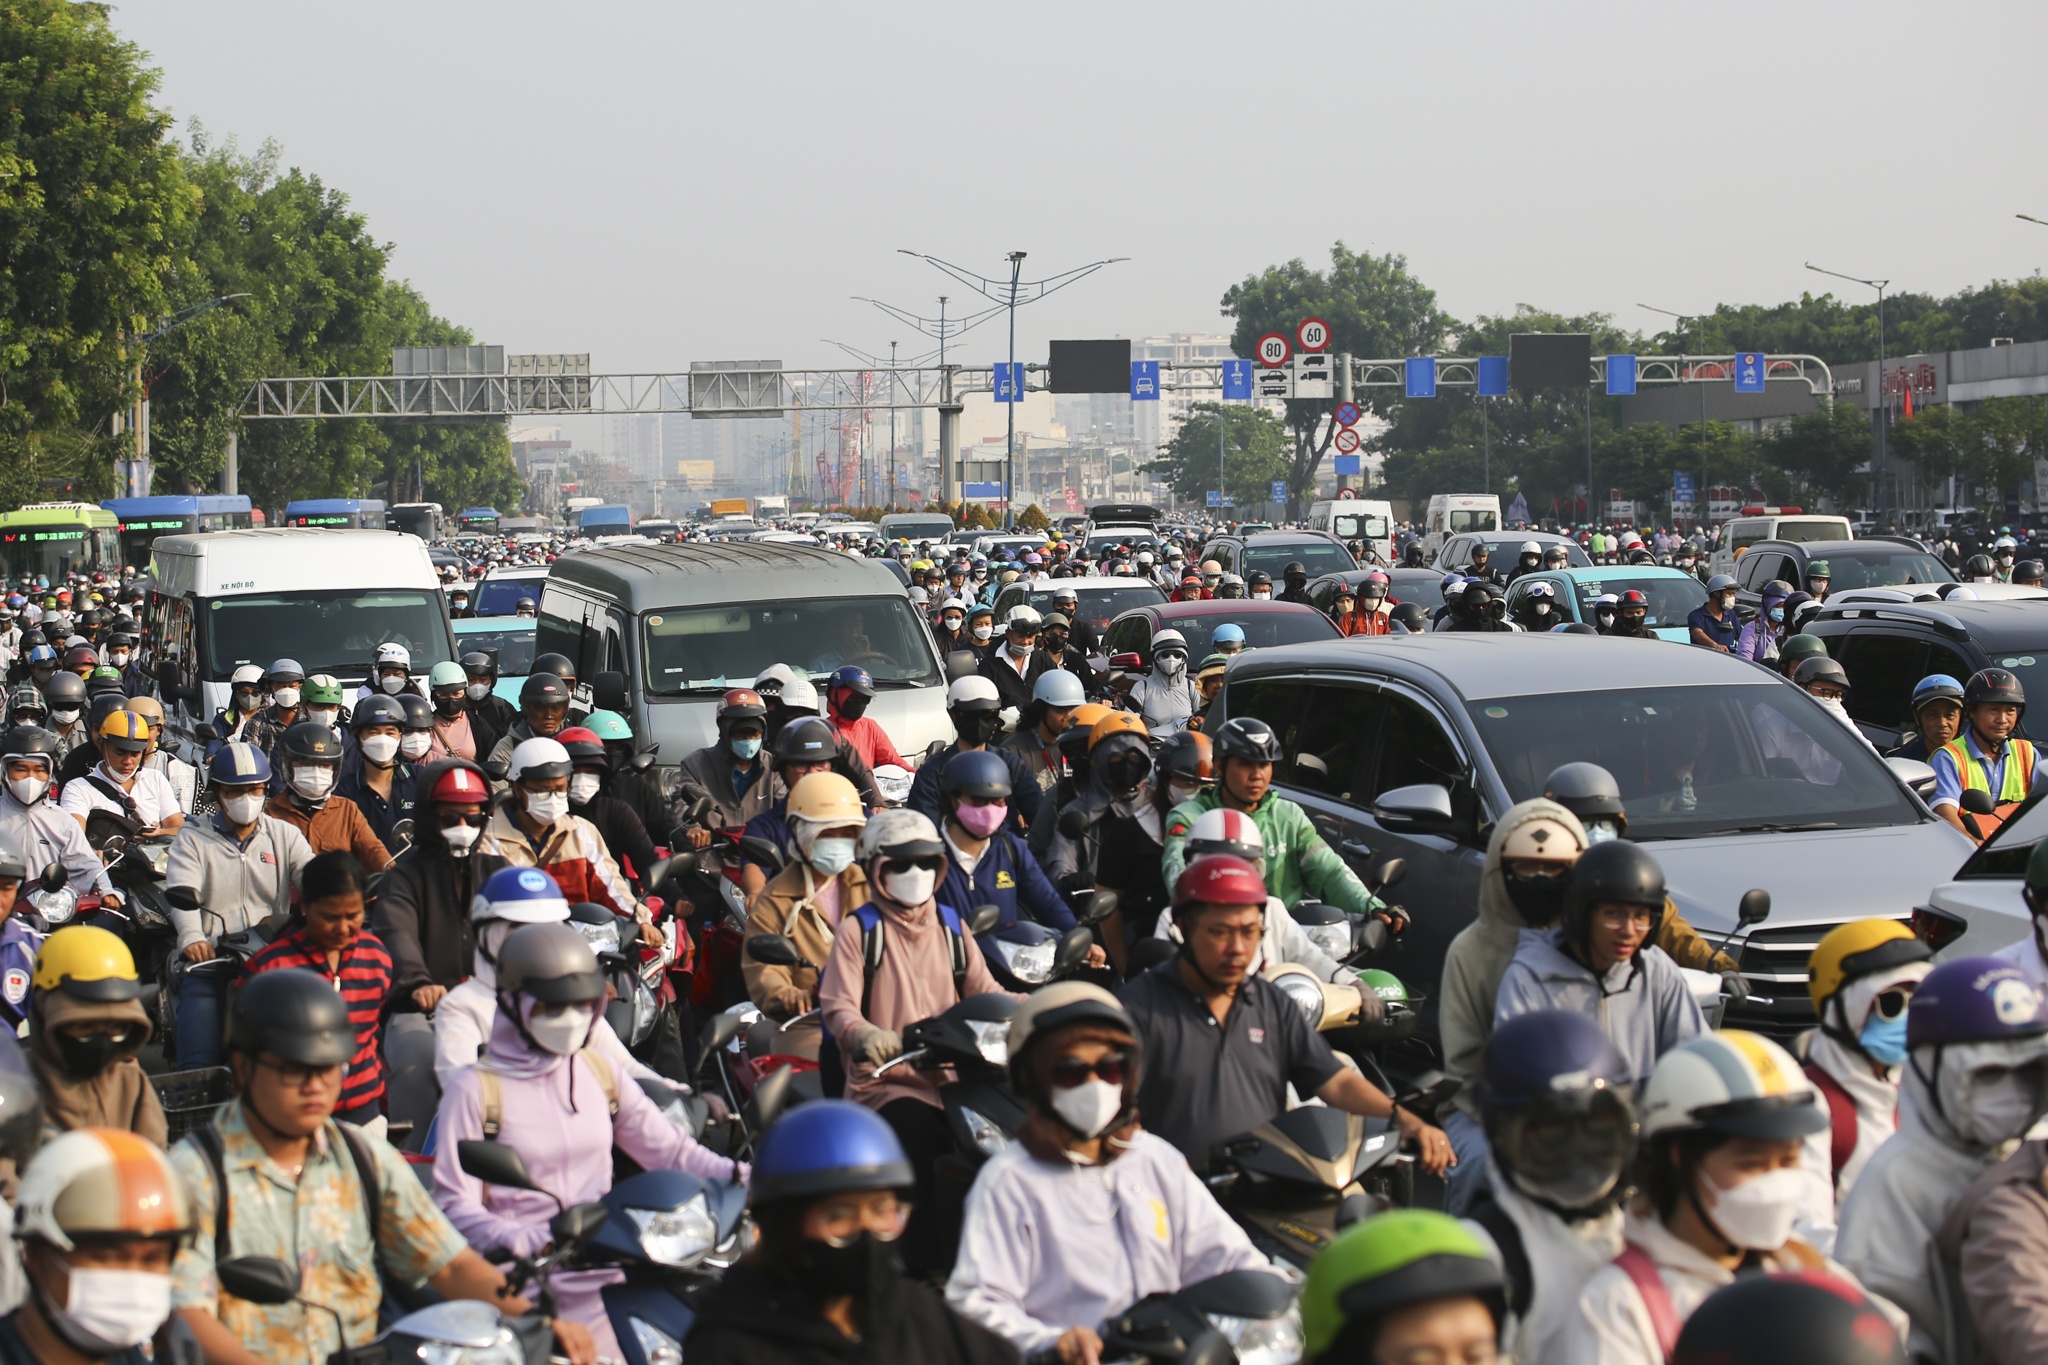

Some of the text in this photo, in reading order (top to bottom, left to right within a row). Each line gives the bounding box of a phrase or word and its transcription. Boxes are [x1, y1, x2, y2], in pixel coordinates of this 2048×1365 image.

[1306, 328, 1321, 342] 60
[1266, 343, 1281, 357] 80
[231, 581, 243, 589] NỘI
[245, 581, 254, 589] BỘ
